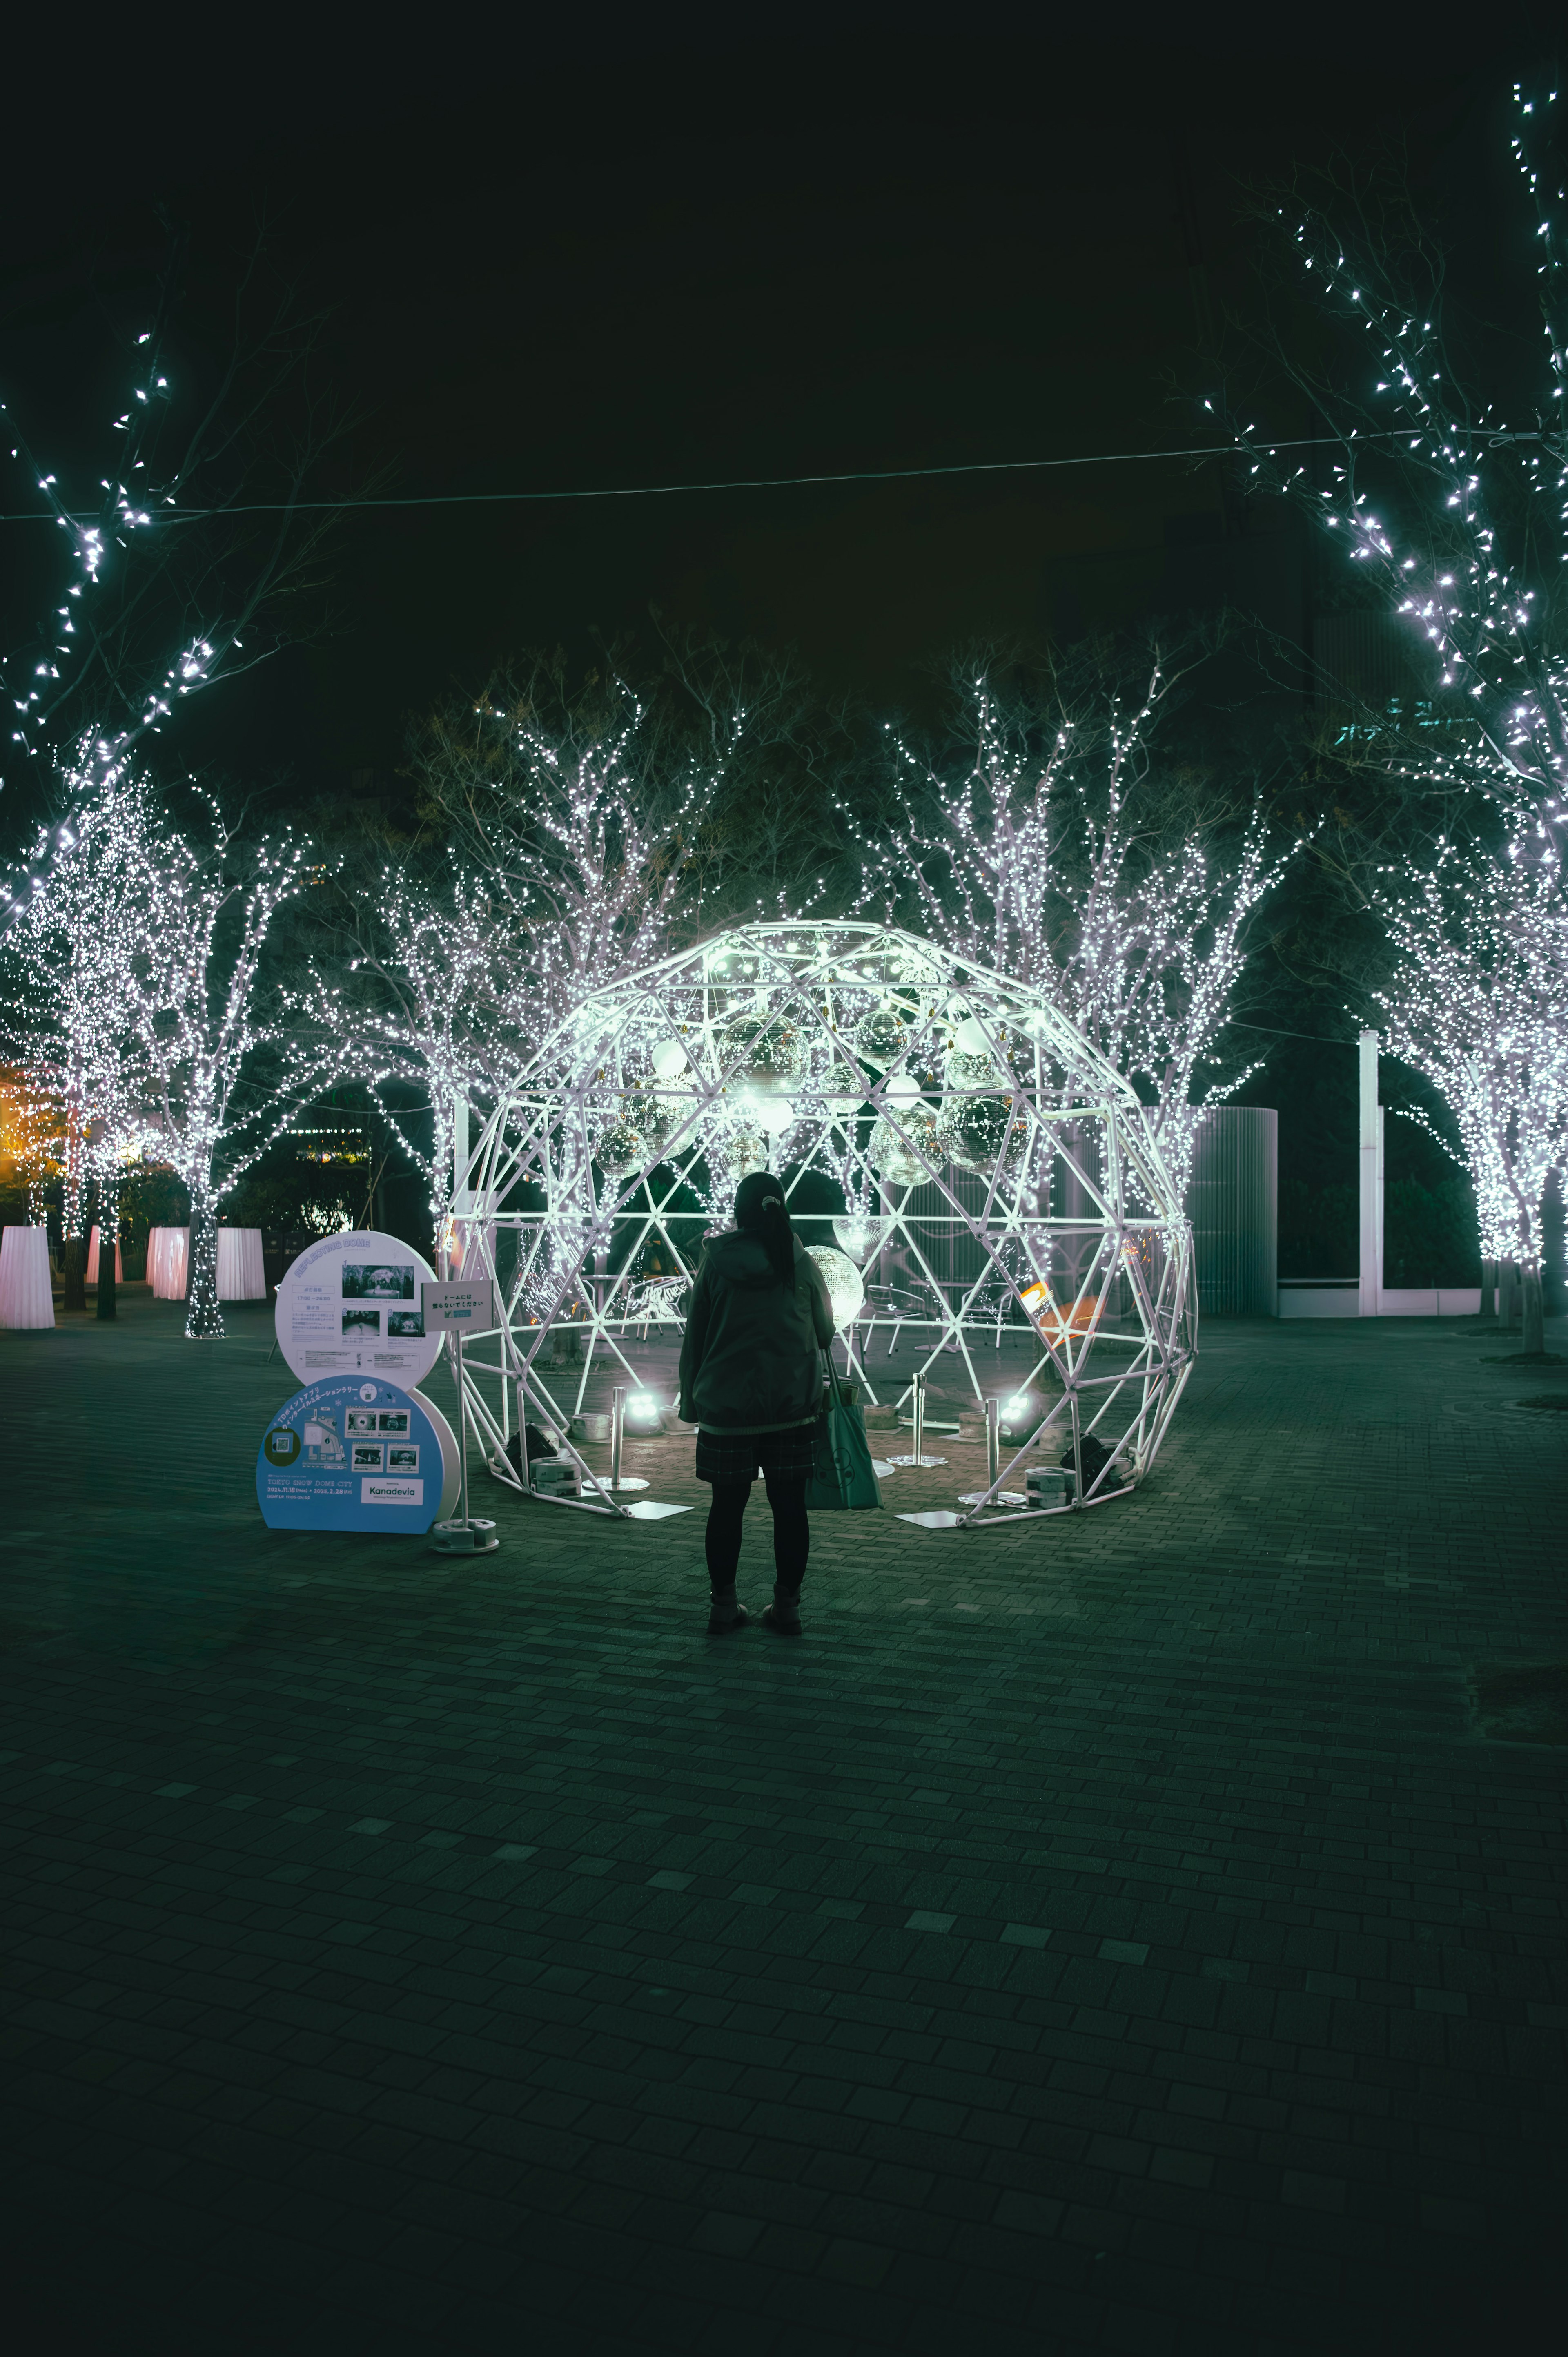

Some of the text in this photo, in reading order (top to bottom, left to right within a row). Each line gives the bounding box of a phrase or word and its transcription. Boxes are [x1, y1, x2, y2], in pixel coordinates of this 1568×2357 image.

[294, 1238, 370, 1278] REFLECTING DOME
[342, 1307, 347, 1316] 2
[388, 1309, 393, 1317] 3
[277, 1387, 319, 1423] TDポイントアプリ
[282, 1386, 358, 1430] ウィンターイルミネーションラリー
[370, 1487, 414, 1495] Kanadevia
